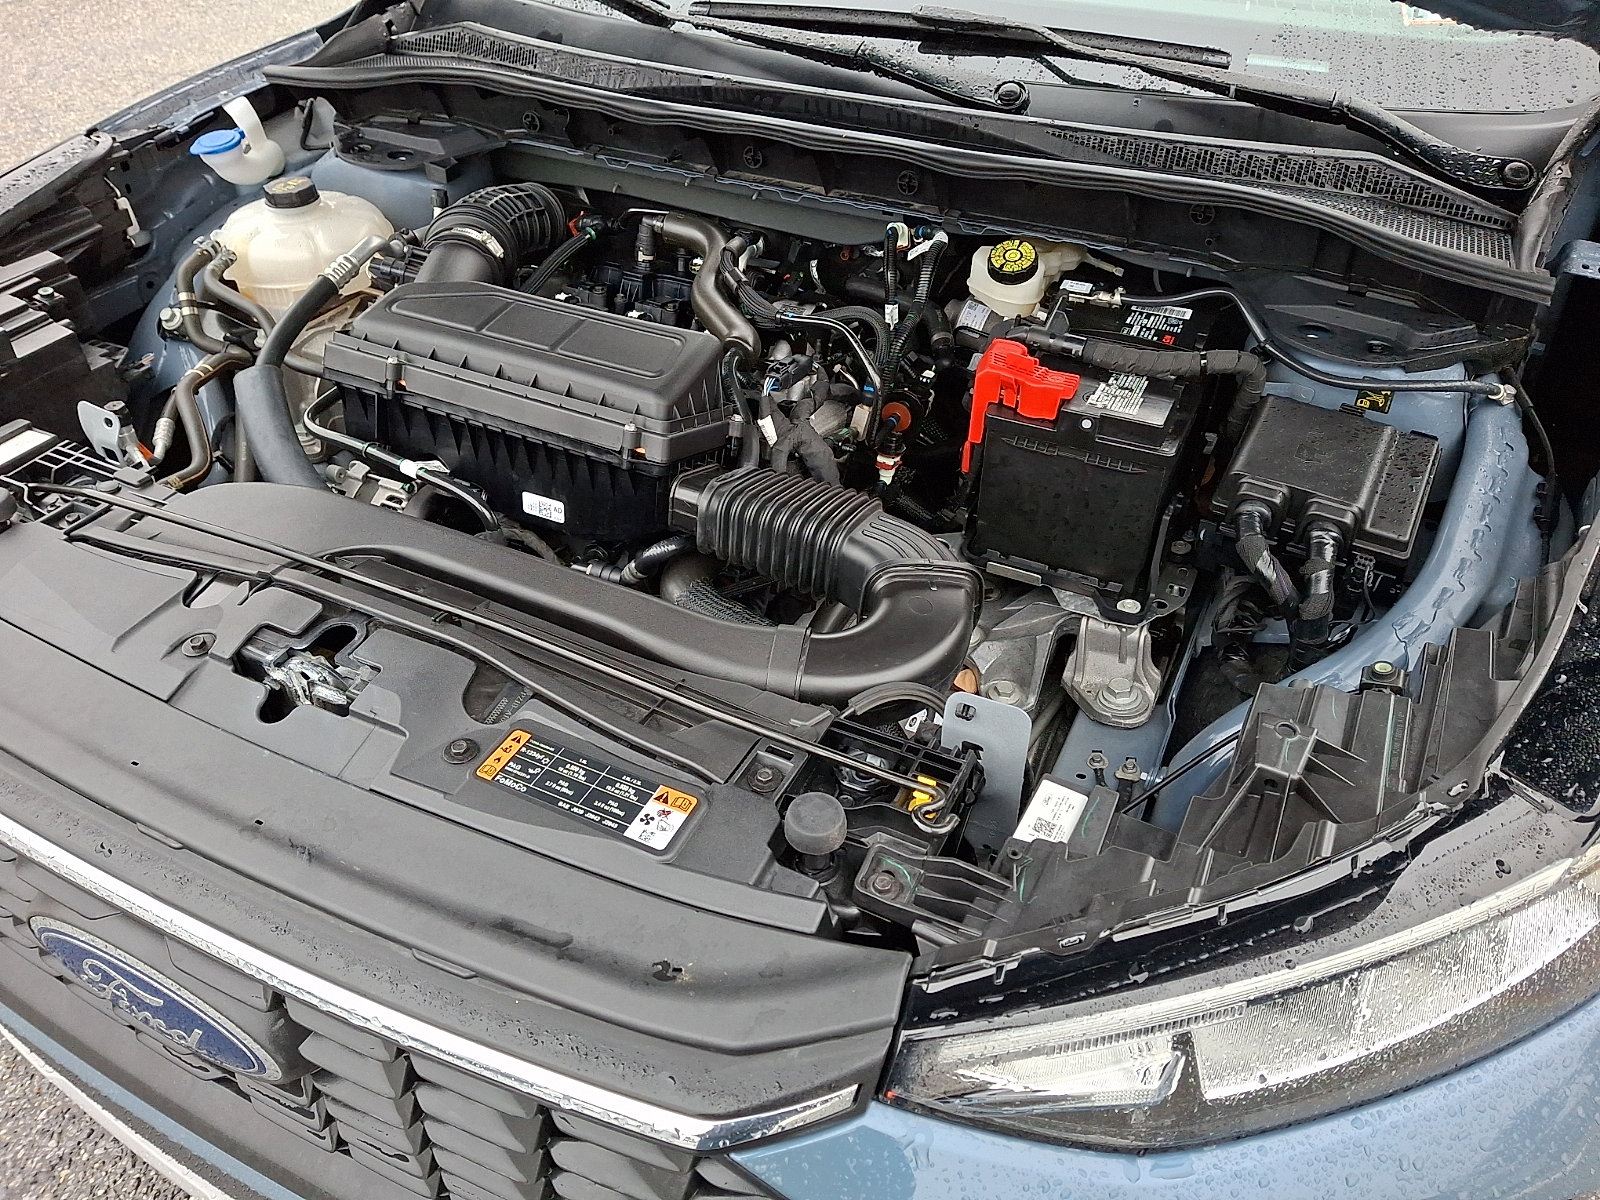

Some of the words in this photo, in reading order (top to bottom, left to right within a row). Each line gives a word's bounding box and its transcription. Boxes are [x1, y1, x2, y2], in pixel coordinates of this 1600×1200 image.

[507, 762, 521, 770] PAG
[494, 775, 527, 792] FoMoCo
[82, 958, 203, 1051] Ford
